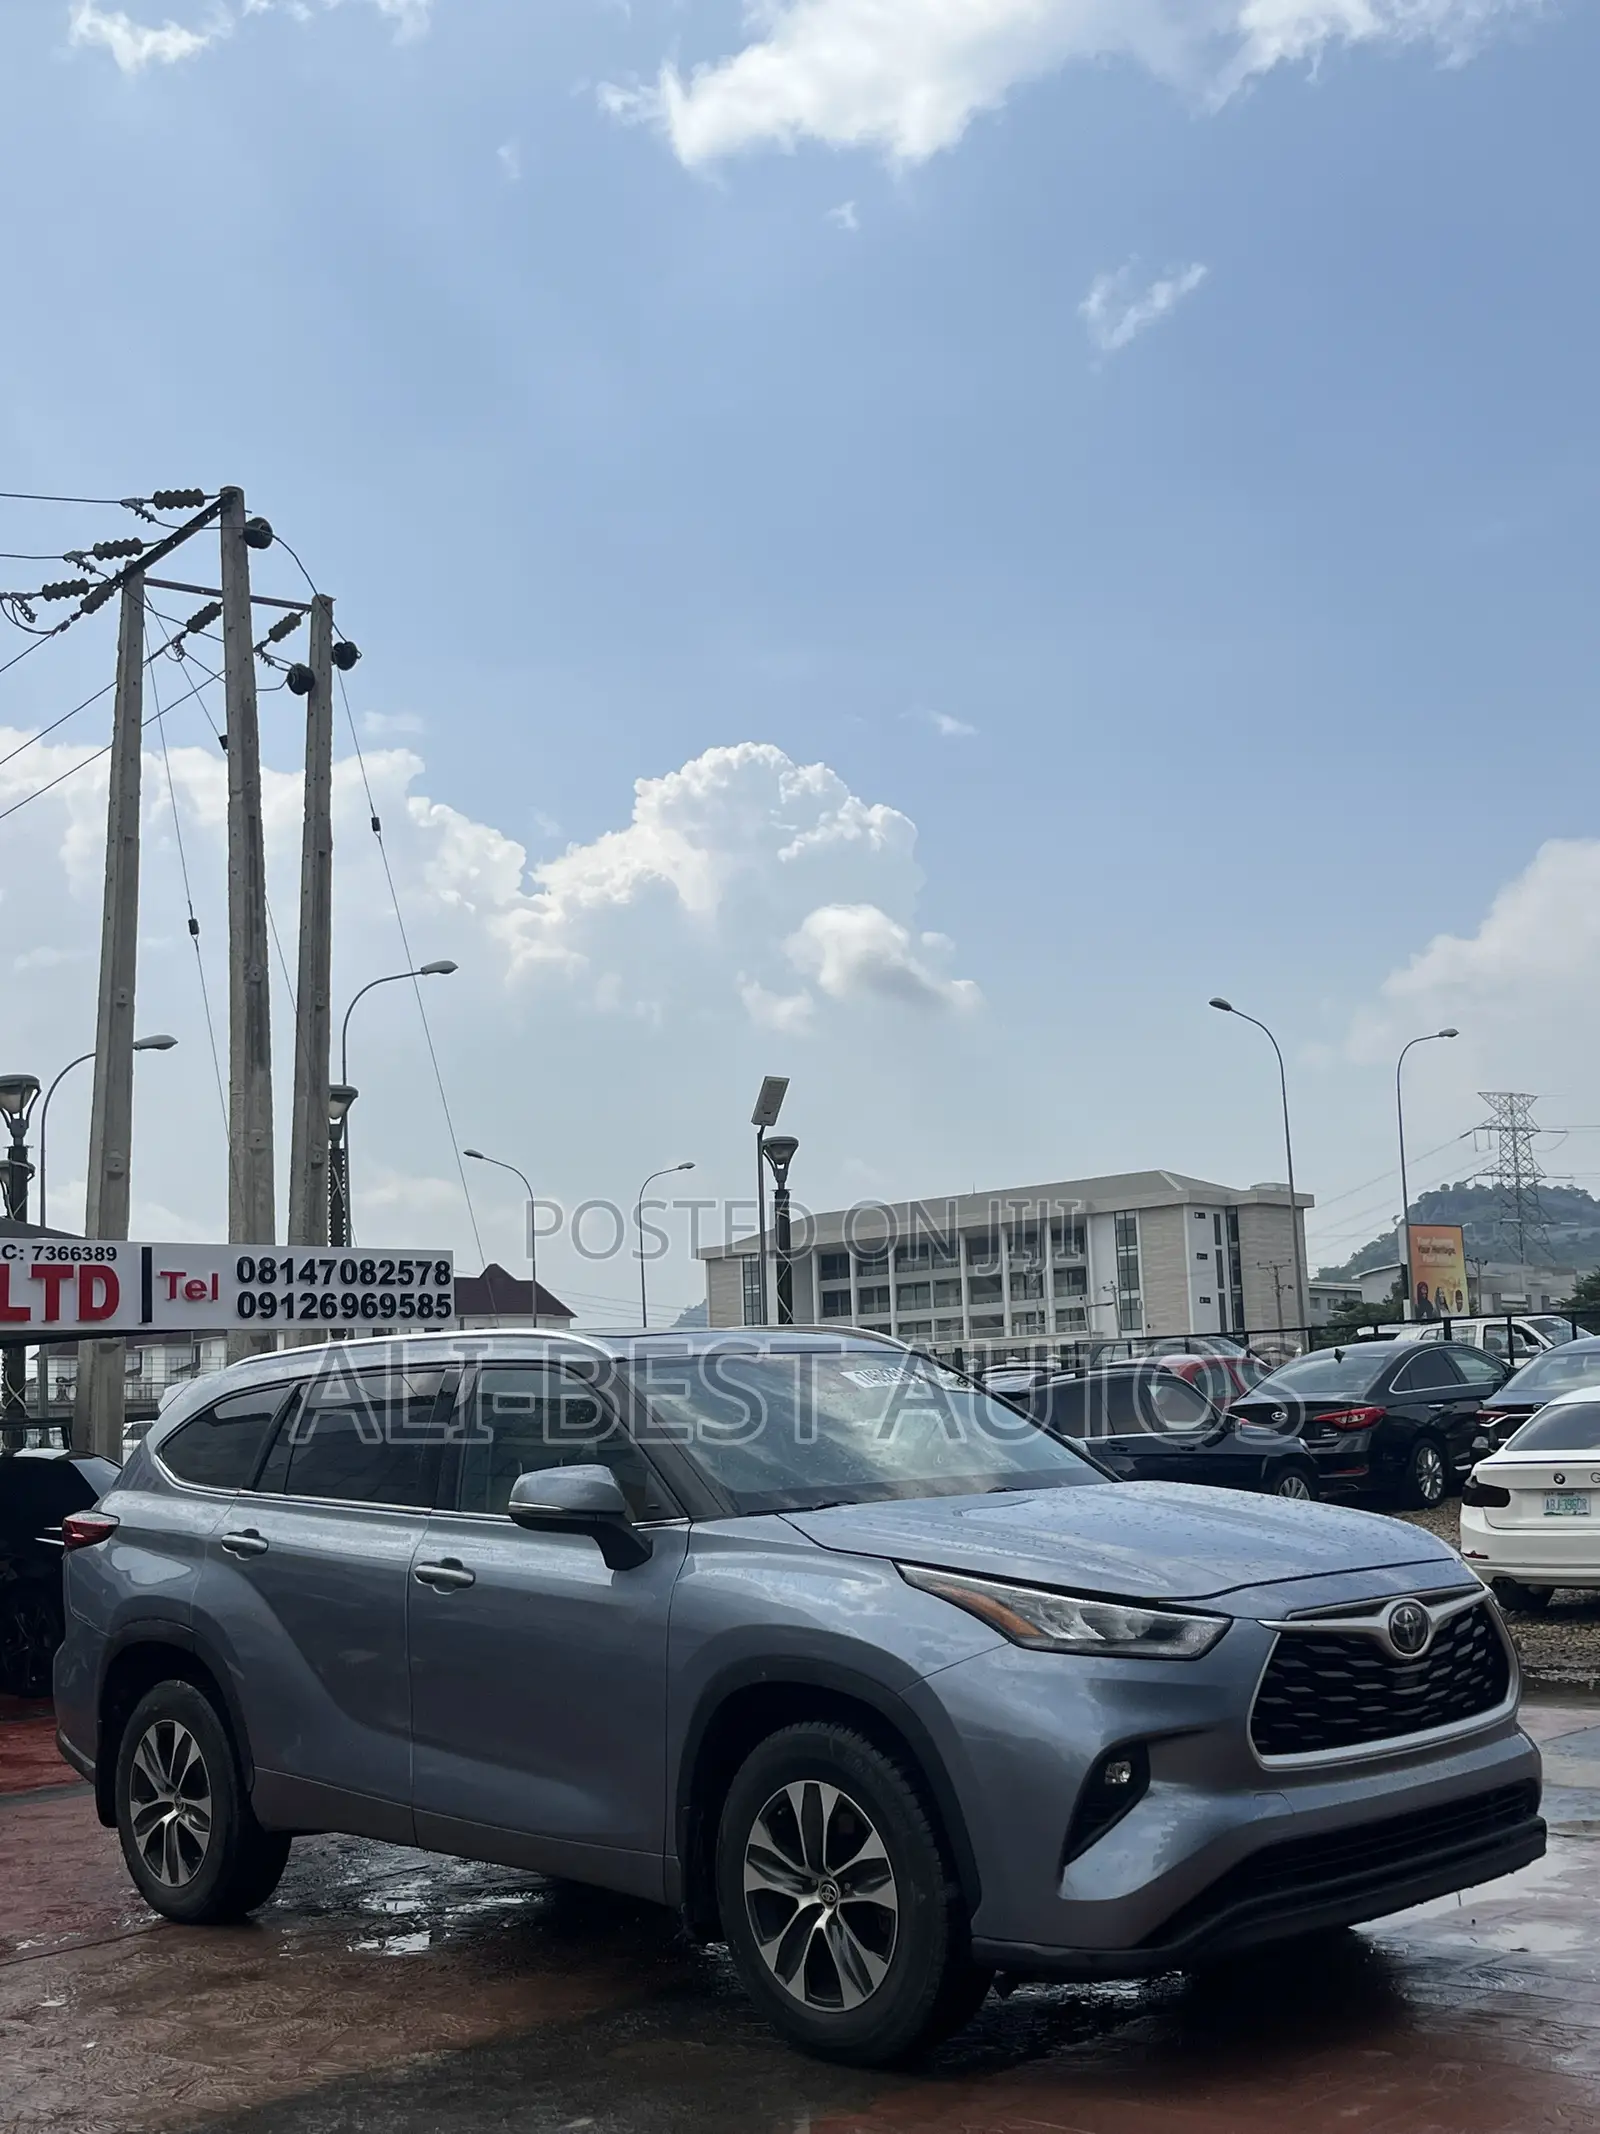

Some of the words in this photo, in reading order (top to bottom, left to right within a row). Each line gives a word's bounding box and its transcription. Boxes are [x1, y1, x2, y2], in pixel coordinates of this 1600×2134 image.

[0, 1244, 24, 1260] C:
[31, 1245, 117, 1261] 7366389
[159, 1270, 219, 1301] Tel
[236, 1256, 451, 1286] 08147082578
[0, 1264, 120, 1322] LTD
[237, 1291, 452, 1319] 09126969585
